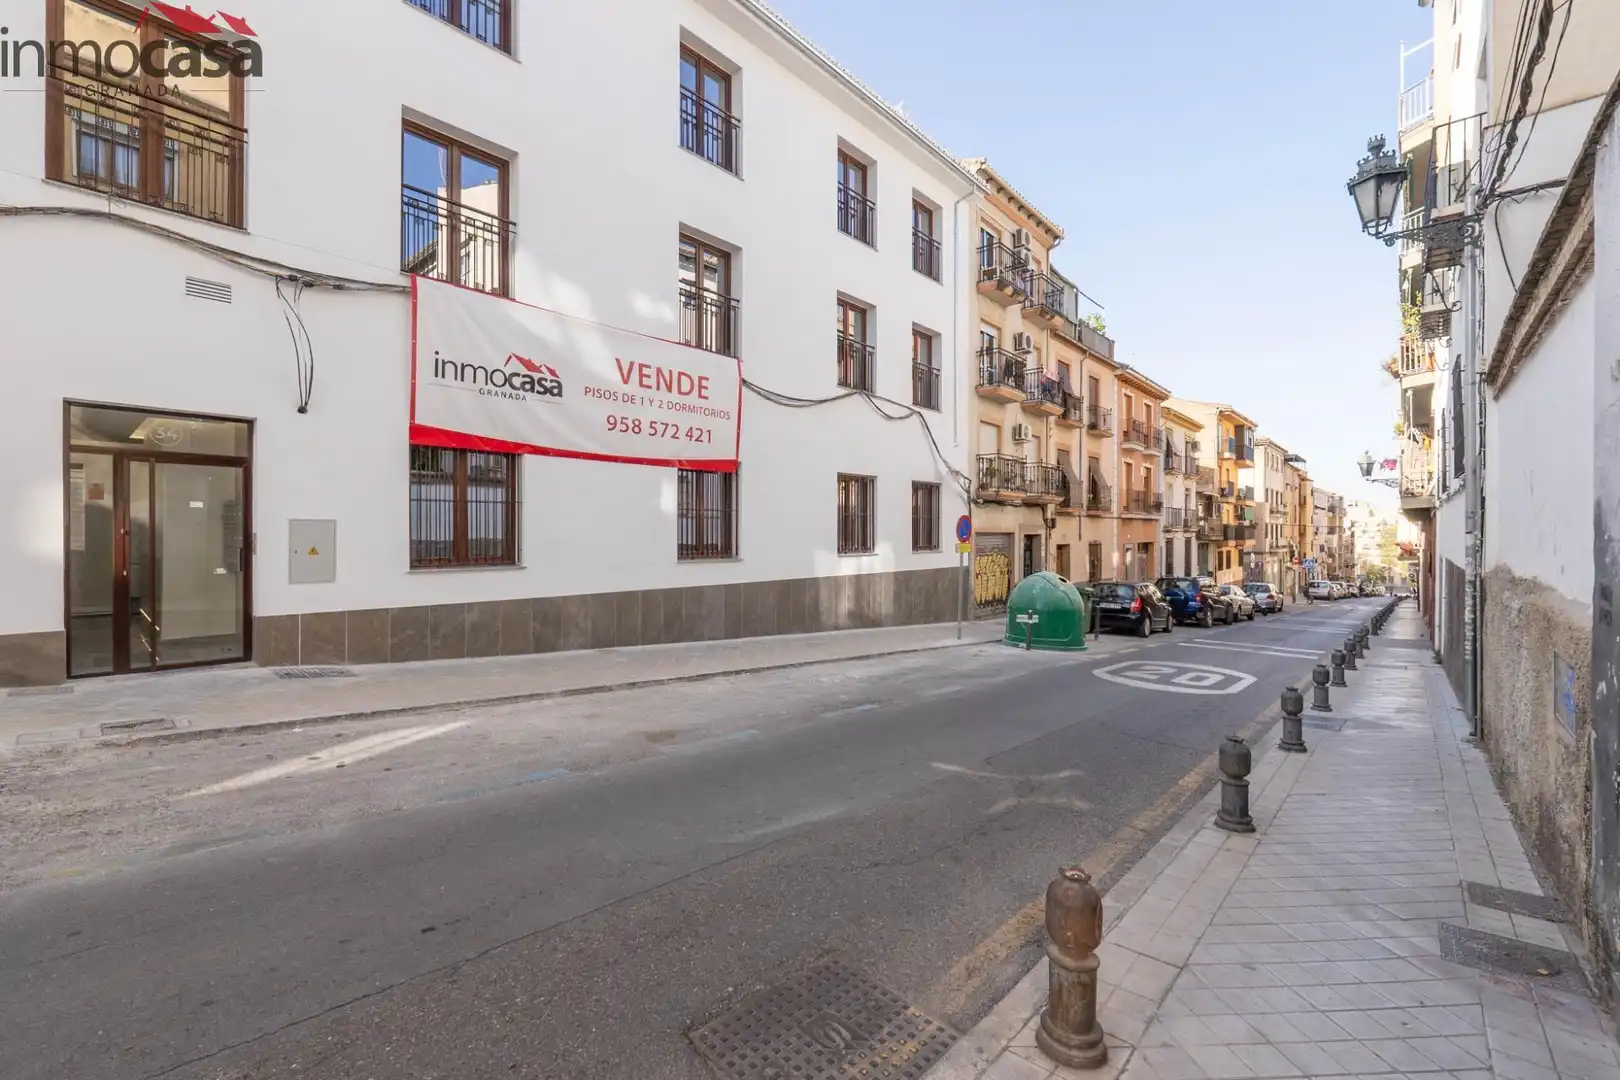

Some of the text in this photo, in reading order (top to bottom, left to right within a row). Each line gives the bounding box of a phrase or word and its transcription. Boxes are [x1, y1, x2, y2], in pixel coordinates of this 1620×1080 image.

[434, 350, 563, 398] inmocasa
[615, 357, 710, 400] VENDE
[479, 387, 527, 401] GRANADA
[584, 386, 731, 420] PISOS DE 1 Y 2 DORMITORIOS
[606, 414, 712, 443] 958 572 421
[1119, 665, 1226, 687] 20
